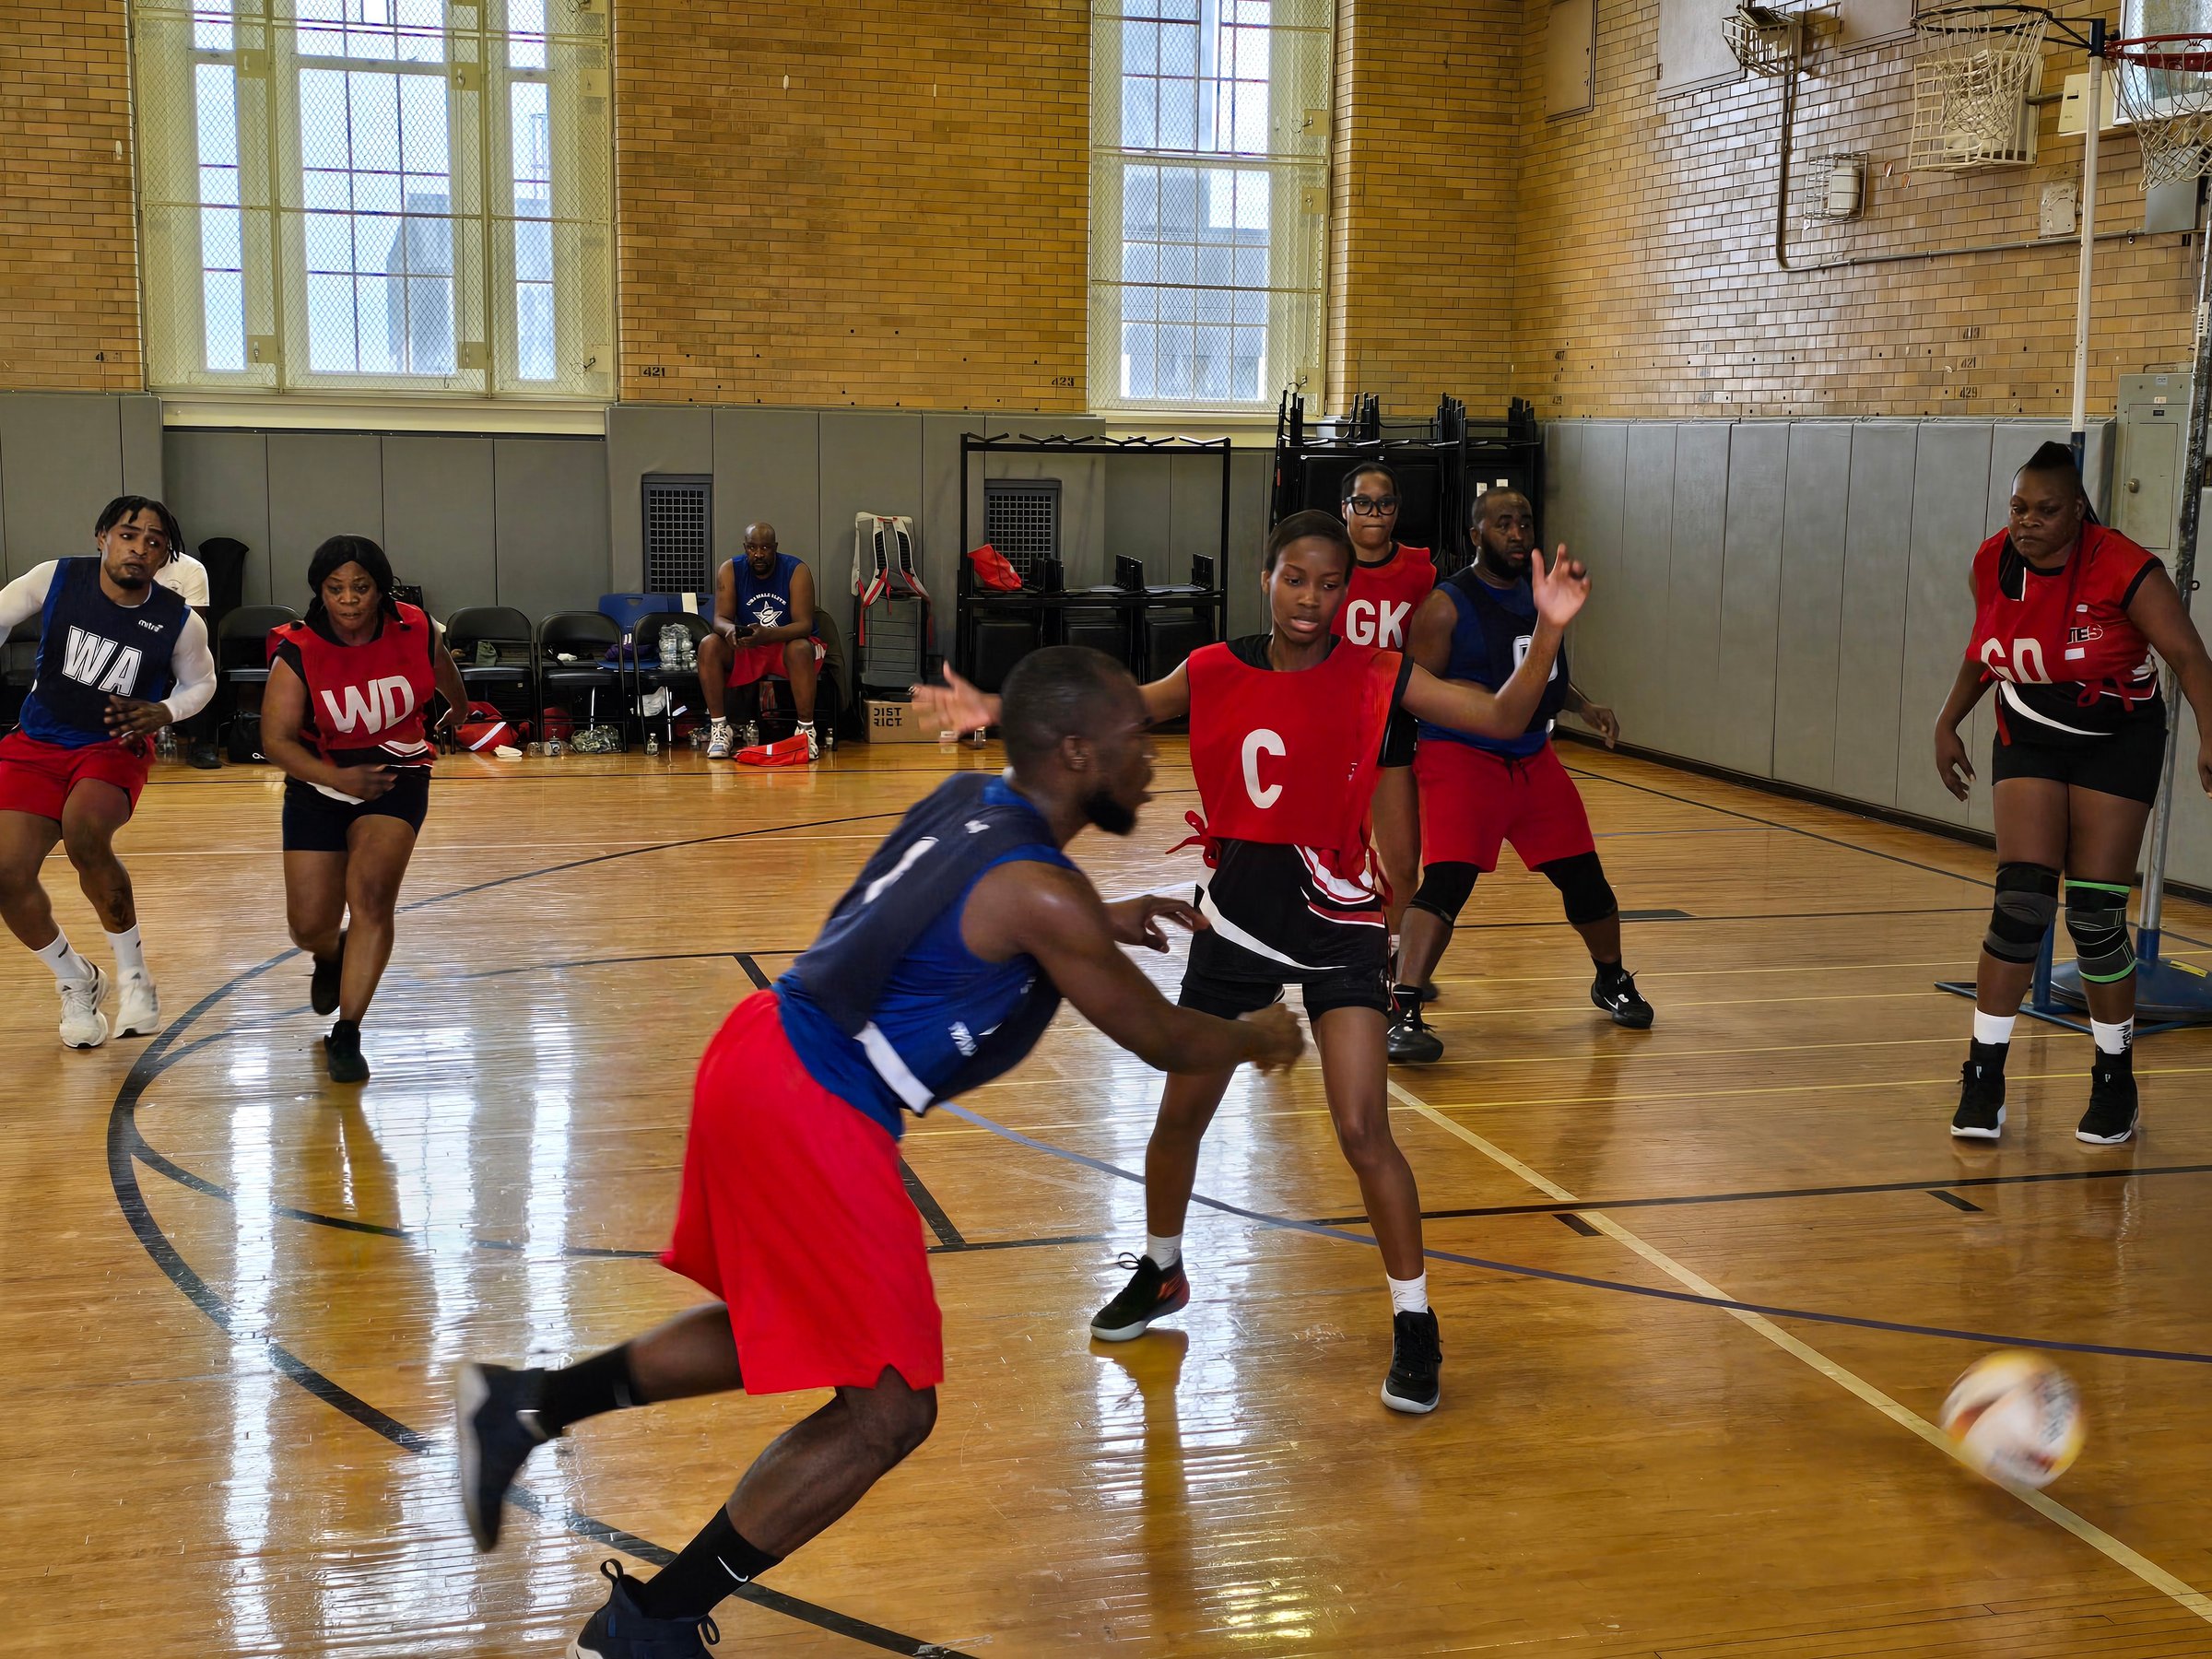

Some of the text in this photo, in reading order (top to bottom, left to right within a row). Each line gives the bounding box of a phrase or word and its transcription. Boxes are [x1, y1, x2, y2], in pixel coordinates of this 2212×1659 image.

[642, 367, 665, 377] 421
[1959, 386, 1978, 398] 429
[1346, 599, 1412, 648] GK
[62, 625, 143, 697] WA
[320, 675, 415, 735] WD
[1241, 728, 1287, 809] C
